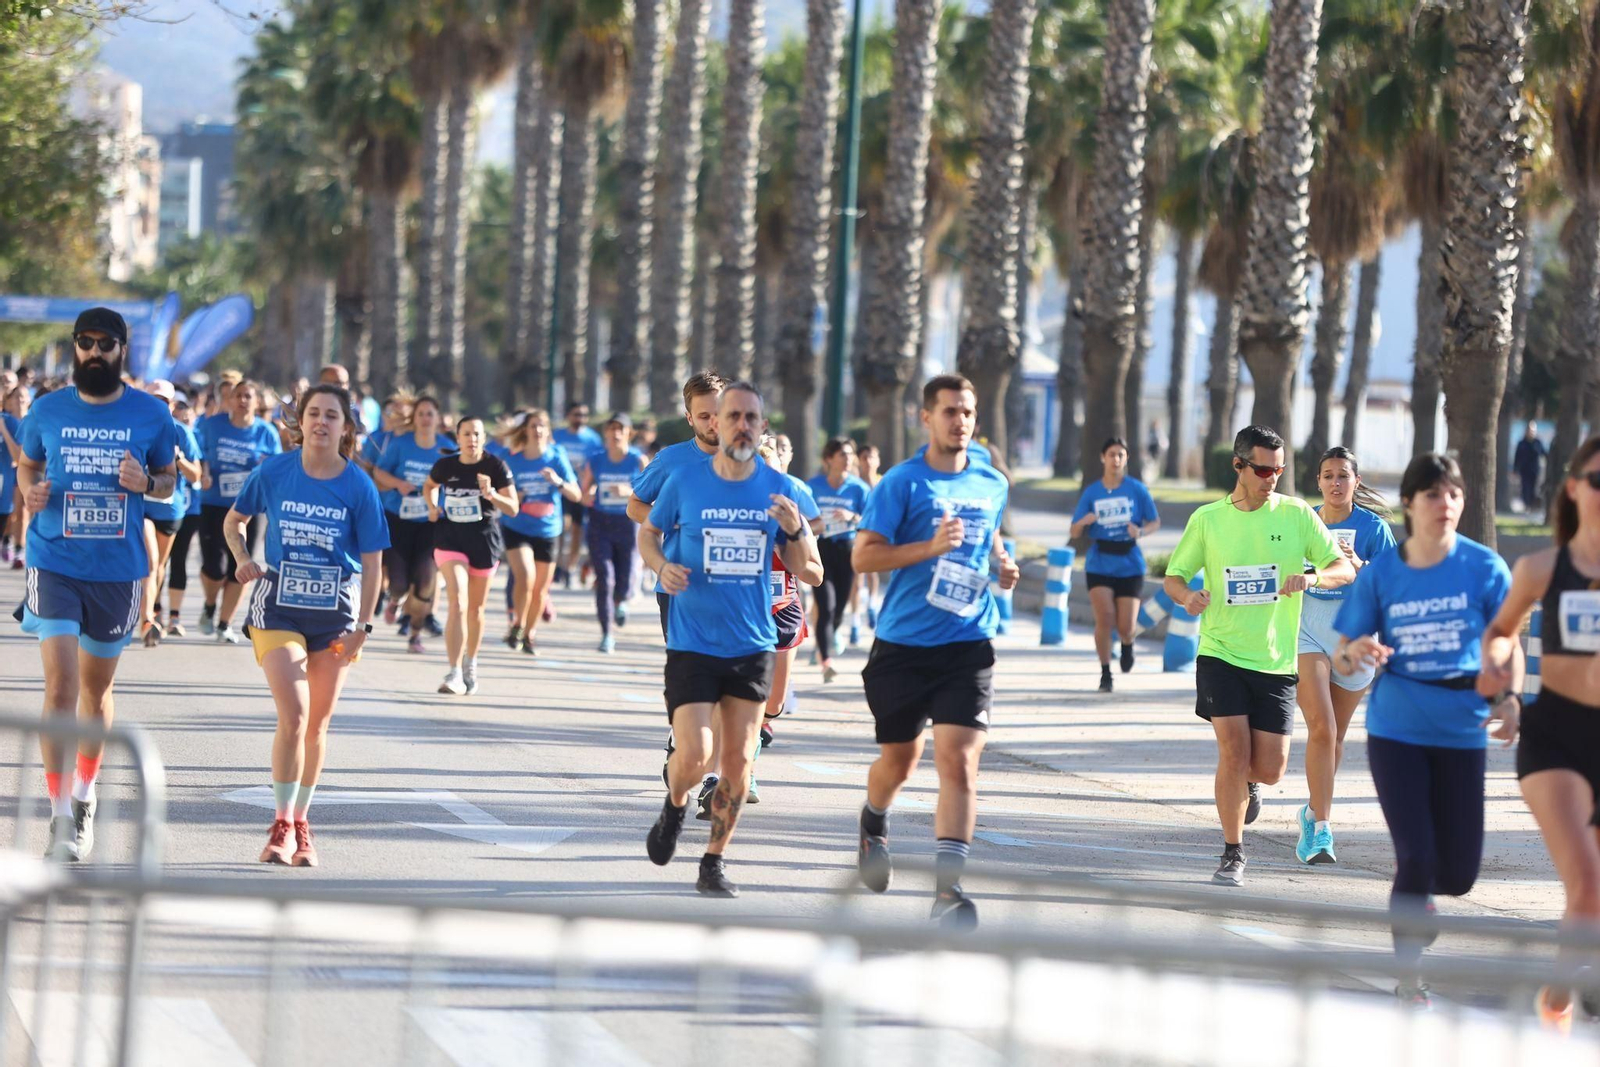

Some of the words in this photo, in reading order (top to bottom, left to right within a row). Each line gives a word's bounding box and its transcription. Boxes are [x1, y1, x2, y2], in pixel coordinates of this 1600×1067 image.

[61, 427, 131, 442] mayoral
[73, 510, 119, 522] 1896
[281, 500, 347, 521] mayoral
[701, 507, 769, 522] mayoral
[712, 547, 758, 562] 1045
[286, 579, 332, 594] 2102
[1235, 580, 1267, 594] 267
[1388, 592, 1468, 618] mayoral
